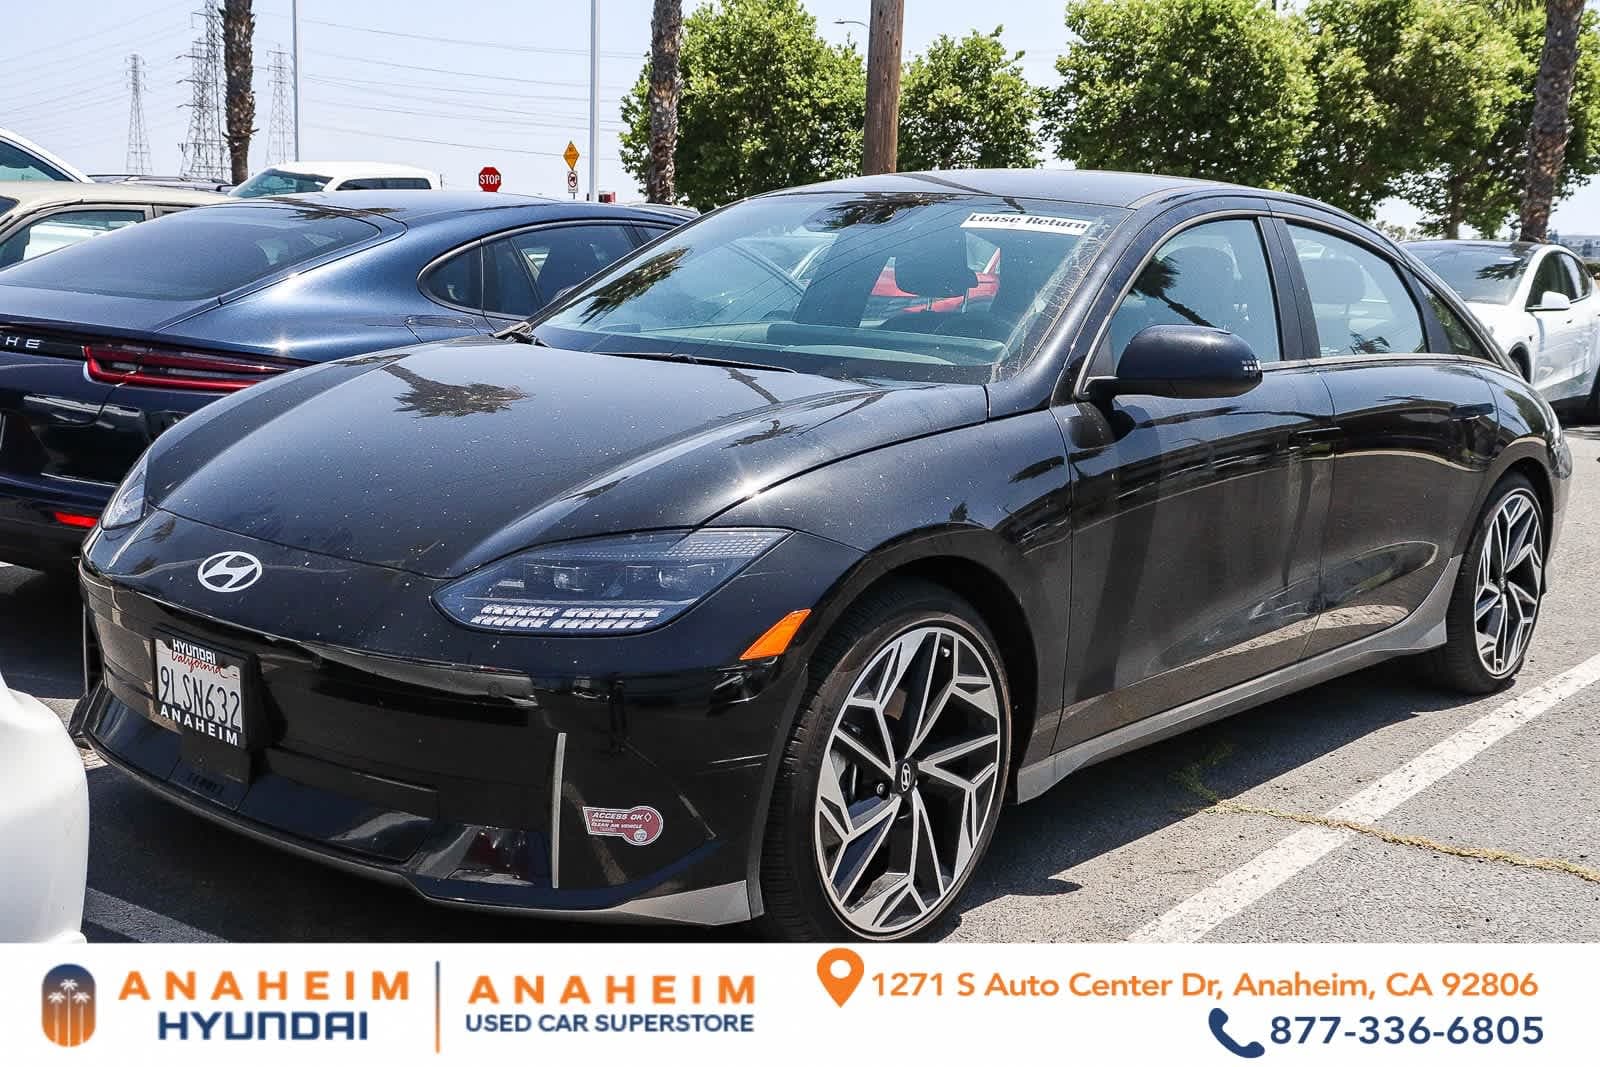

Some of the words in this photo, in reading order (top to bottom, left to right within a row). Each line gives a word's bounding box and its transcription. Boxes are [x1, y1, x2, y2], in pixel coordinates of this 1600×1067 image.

[479, 174, 500, 185] STOP
[969, 214, 1021, 223] Lease
[1025, 216, 1087, 230] Return
[172, 638, 216, 665] HYUNDAI
[160, 665, 242, 732] 9LSN632
[160, 704, 238, 746] ANAHEIM
[592, 812, 628, 820] ACCESS
